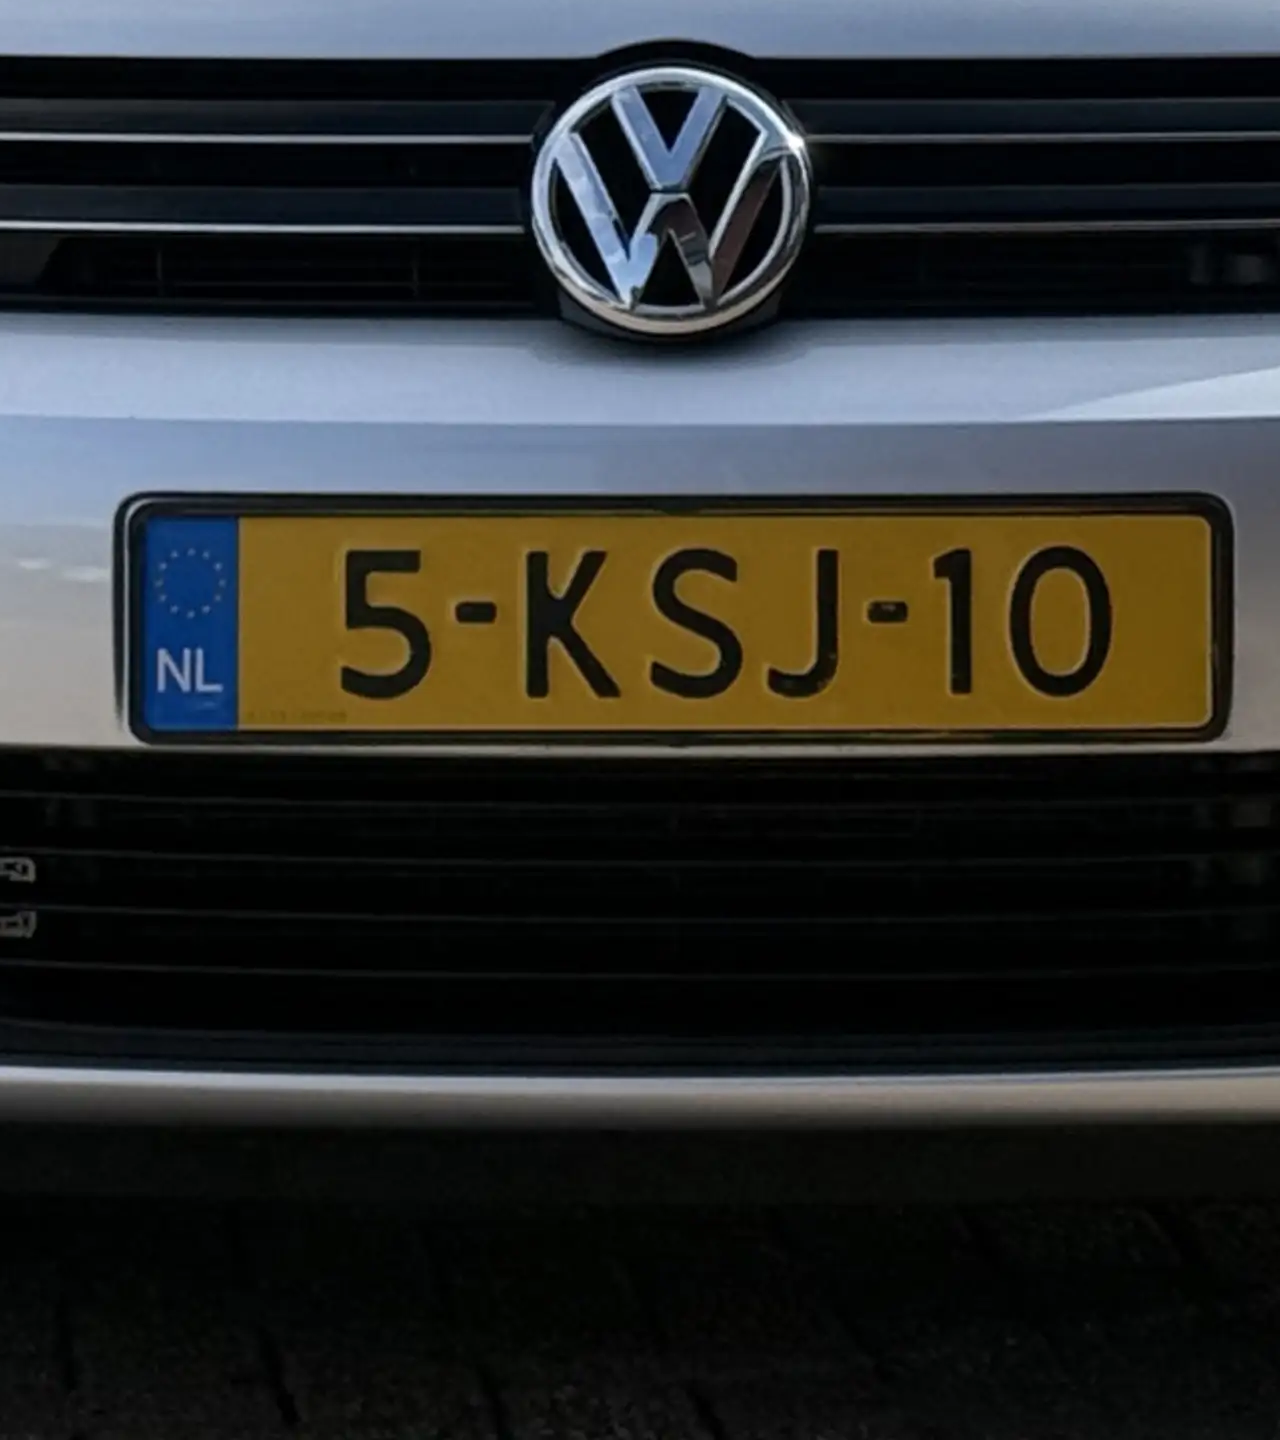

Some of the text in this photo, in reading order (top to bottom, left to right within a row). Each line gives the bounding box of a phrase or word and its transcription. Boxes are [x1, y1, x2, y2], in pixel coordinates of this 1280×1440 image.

[542, 76, 798, 322] VW
[157, 647, 224, 693] NL
[341, 545, 1113, 700] 5-KSJ-10
